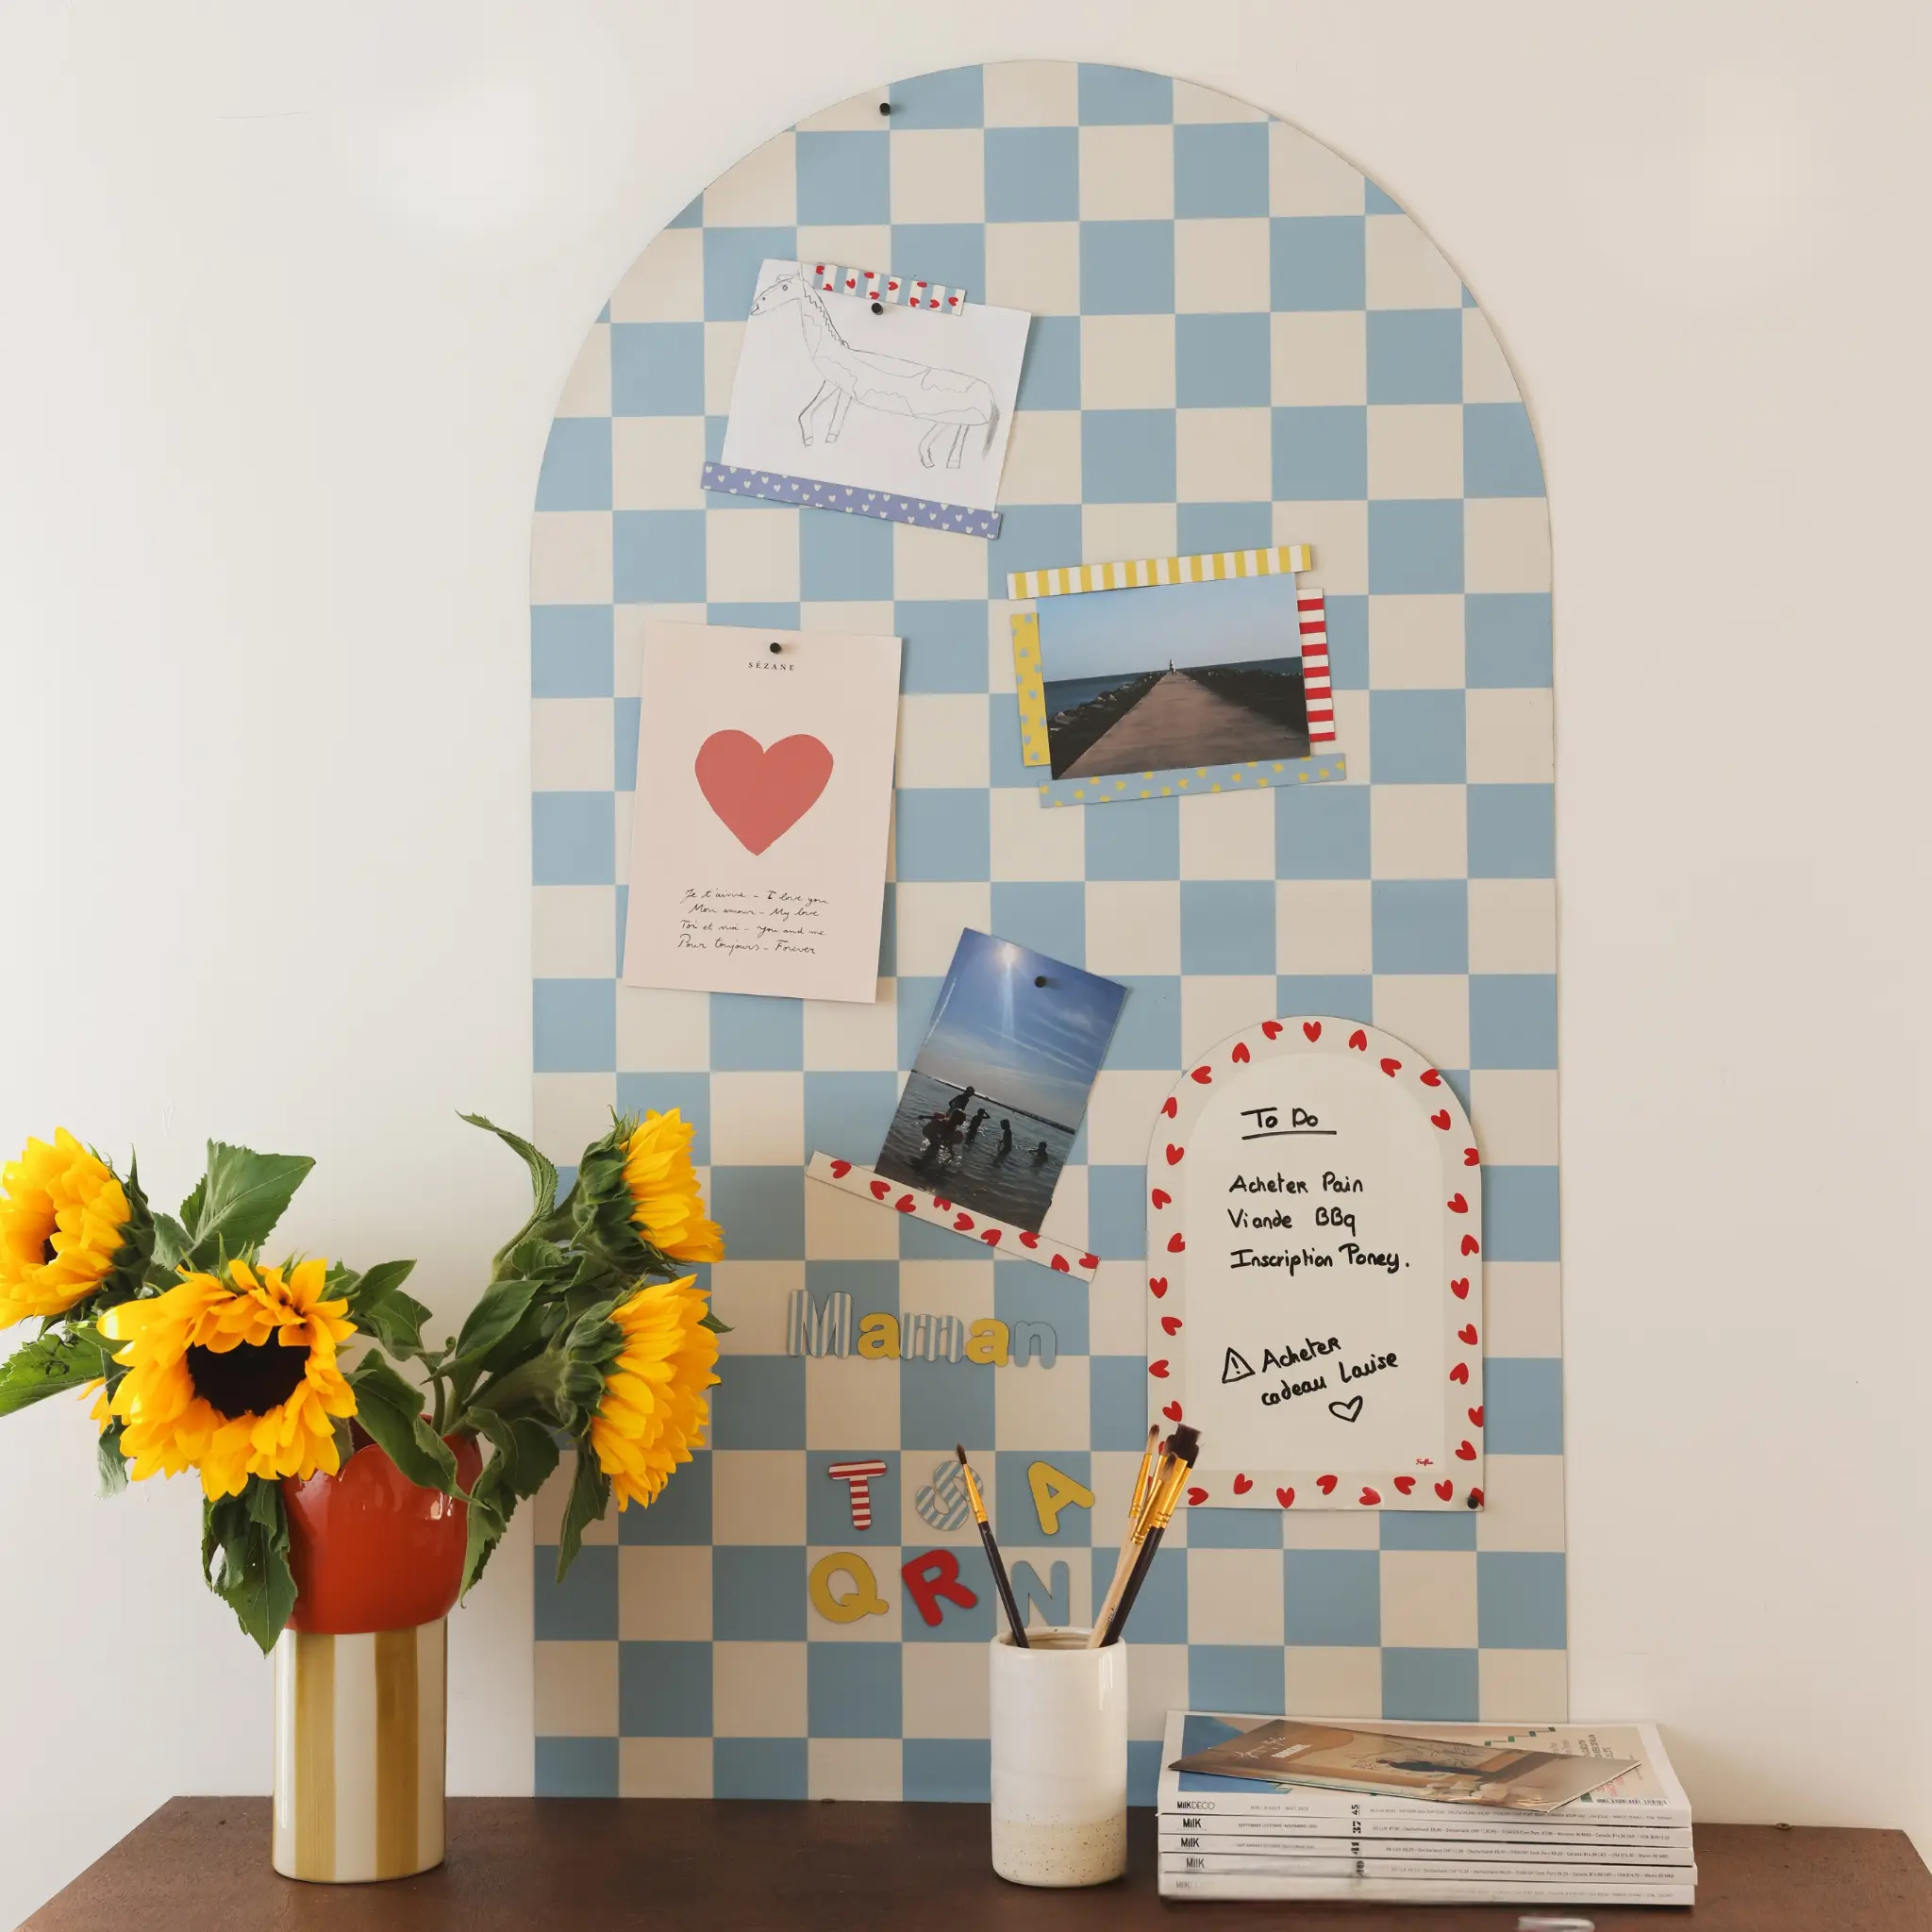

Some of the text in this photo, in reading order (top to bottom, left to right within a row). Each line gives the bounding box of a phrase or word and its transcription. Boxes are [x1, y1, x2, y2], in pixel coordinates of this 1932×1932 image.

[748, 661, 794, 671] SÉZANE
[767, 891, 776, 899] I
[779, 891, 803, 901] love
[808, 896, 828, 907] you
[689, 903, 718, 913] Mon
[769, 908, 790, 922] My
[794, 908, 820, 916] love
[677, 933, 707, 948] Pour
[714, 937, 759, 956] toujours
[774, 940, 815, 955] Forever
[1241, 1107, 1319, 1128] To Do
[1323, 1171, 1363, 1192] Pain
[1227, 1208, 1293, 1229] Viande
[1230, 1247, 1333, 1277] Inscription
[787, 1290, 1057, 1369] Maman
[1261, 1375, 1327, 1406] cadeau
[828, 1459, 888, 1530] T
[1027, 1460, 1095, 1535] A
[808, 1548, 1070, 1630] Q R N
[1351, 1804, 1358, 1816] 45
[1182, 1818, 1202, 1828] MilK
[1352, 1820, 1361, 1834] 37
[1180, 1838, 1200, 1847] MilK
[1186, 1858, 1205, 1868] MilK
